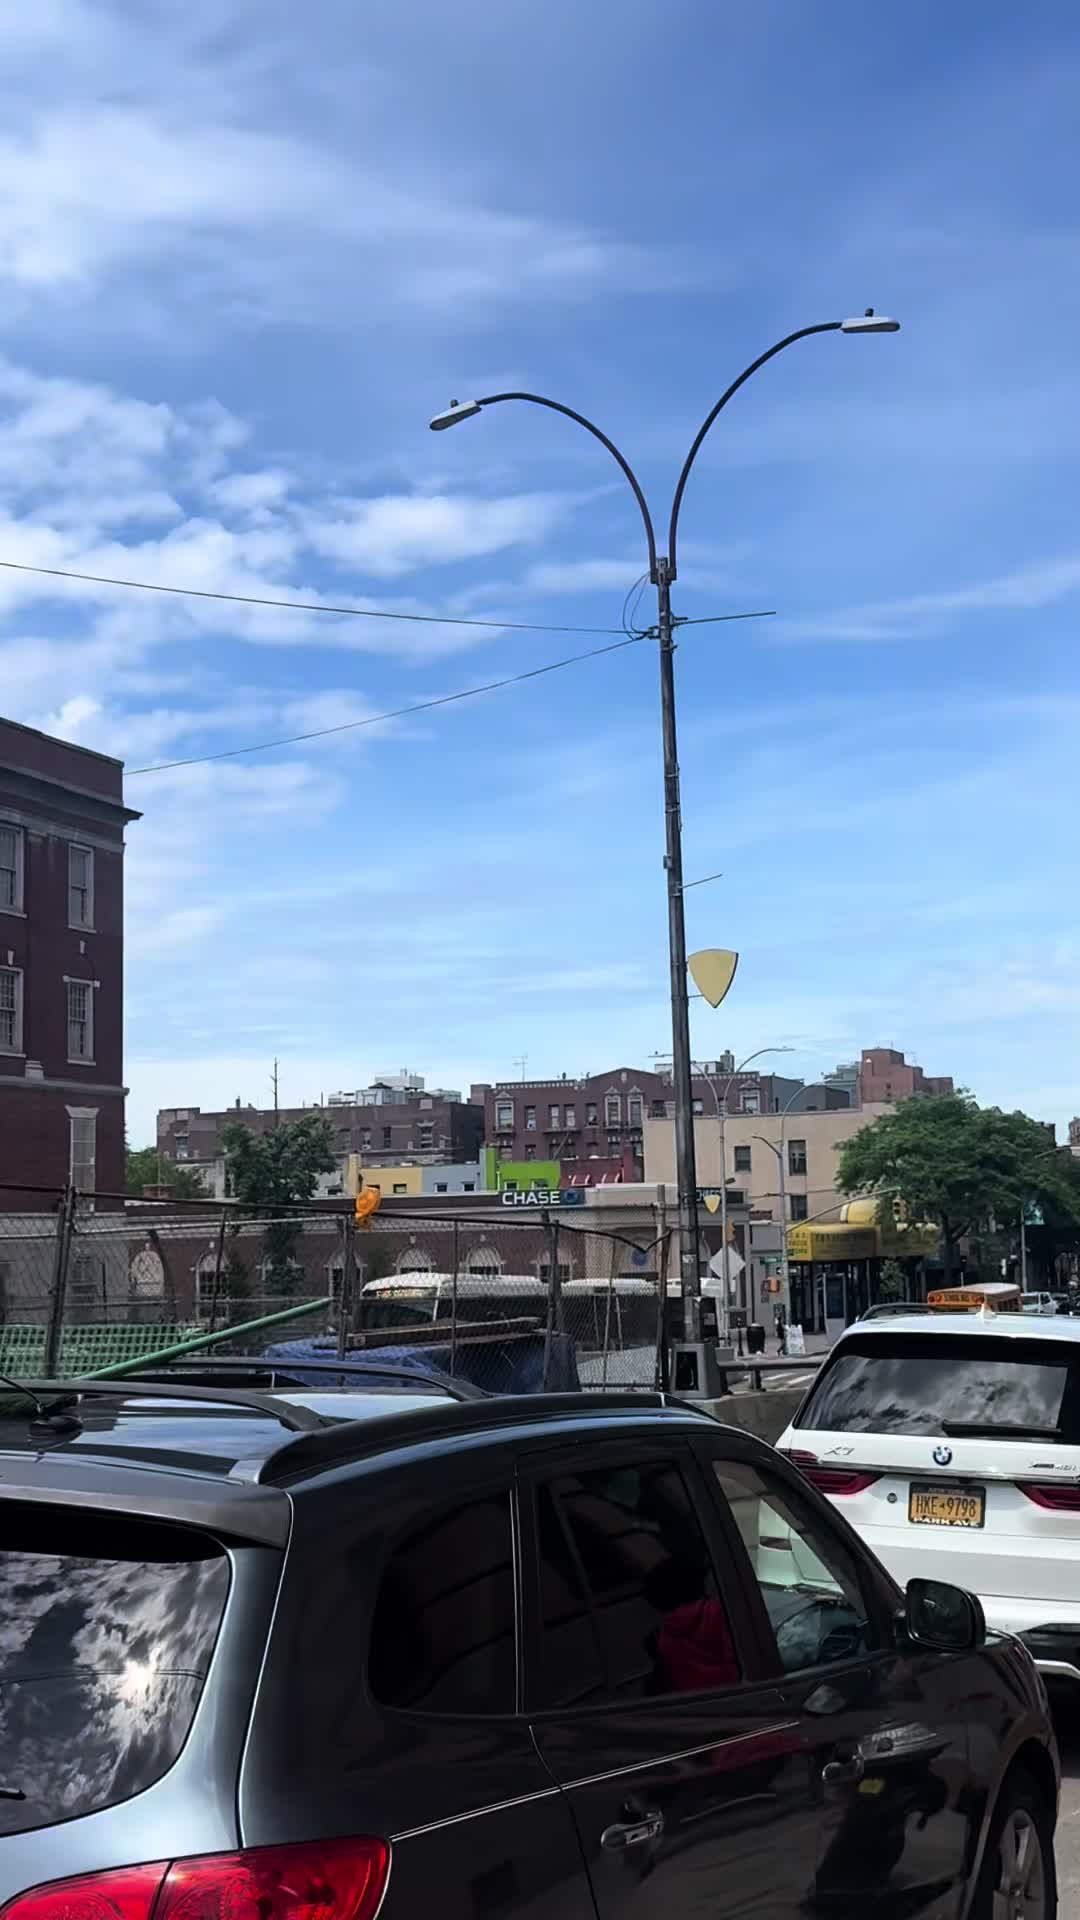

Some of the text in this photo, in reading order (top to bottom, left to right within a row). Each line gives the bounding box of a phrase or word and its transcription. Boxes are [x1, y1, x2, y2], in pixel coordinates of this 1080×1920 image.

[502, 1191, 560, 1205] CHASE
[915, 1495, 977, 1518] HKE 9798
